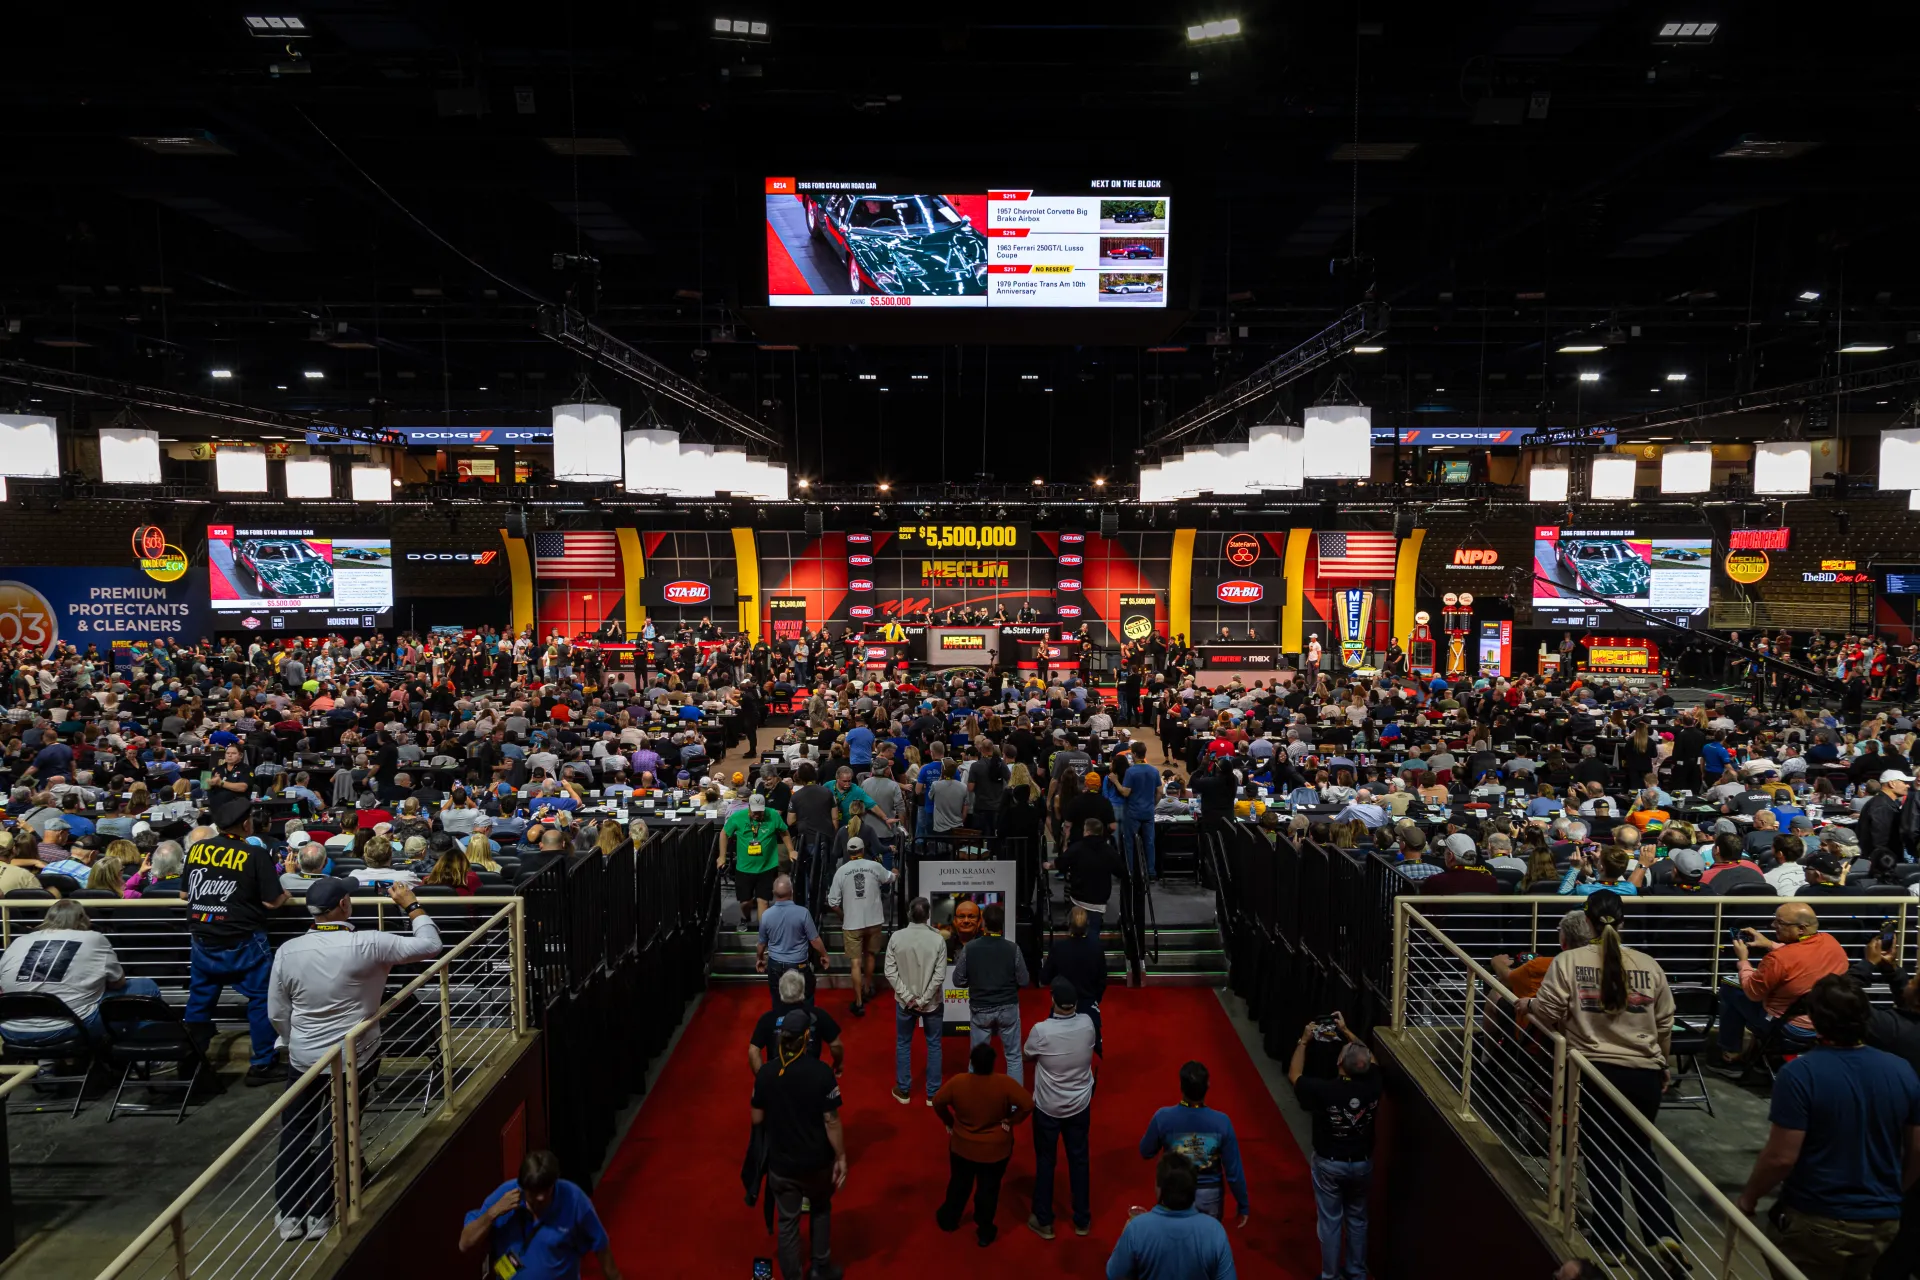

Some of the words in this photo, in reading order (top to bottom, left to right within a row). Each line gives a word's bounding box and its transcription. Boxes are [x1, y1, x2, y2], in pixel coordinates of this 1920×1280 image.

[1091, 180, 1109, 188] NEXT
[1110, 180, 1121, 188] ON
[1122, 180, 1136, 188] THE
[1137, 180, 1161, 188] BLOCK
[1076, 208, 1088, 217] Big
[996, 288, 1036, 296] Anniversary
[870, 297, 911, 307] $5,500,000
[919, 525, 1017, 550] $5,500,000
[1453, 549, 1498, 565] NPD
[921, 560, 1009, 578] MECUM
[1728, 563, 1763, 574] SOLD
[921, 578, 1009, 587] AUCTIONS
[90, 587, 167, 600] PREMIUM
[667, 587, 707, 597] STA-BIL
[1220, 586, 1260, 597] STA-BIL
[69, 603, 190, 616] PROTECTANTS
[1348, 590, 1360, 637] MECUM
[77, 620, 89, 632] &
[93, 620, 182, 632] CLEANERS
[327, 617, 359, 626] HOUSTON
[1568, 617, 1585, 625] INDY
[0, 612, 46, 645] 03
[905, 626, 923, 634] Farm
[1012, 626, 1031, 634] State
[1032, 626, 1050, 634] Farm
[1127, 623, 1151, 637] SOLD
[943, 636, 982, 645] MECUM
[1502, 626, 1510, 645] TULSA
[1248, 655, 1270, 663] max
[1591, 649, 1647, 666] MECUM
[188, 843, 249, 872] NASCAR
[939, 868, 960, 876] JOHN
[187, 867, 238, 903] Racing
[1575, 965, 1595, 976] CHEVY
[944, 989, 970, 999] MEC
